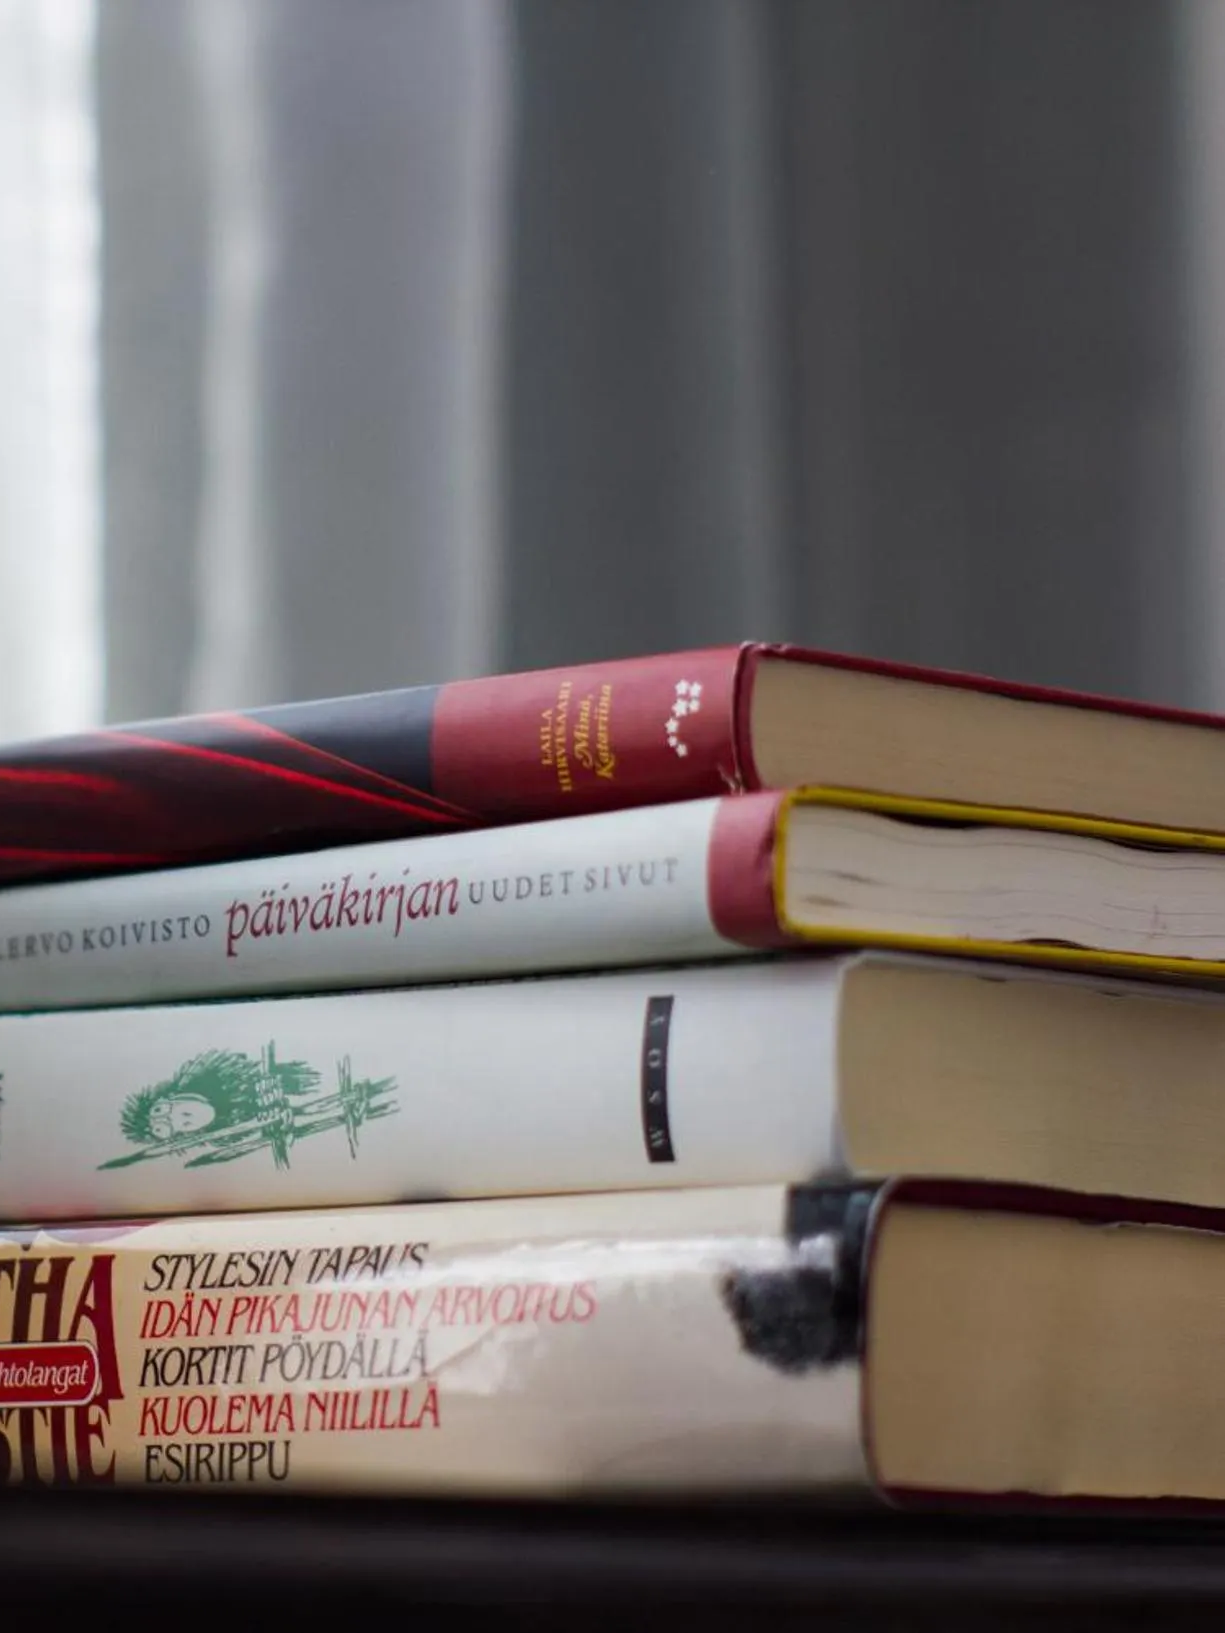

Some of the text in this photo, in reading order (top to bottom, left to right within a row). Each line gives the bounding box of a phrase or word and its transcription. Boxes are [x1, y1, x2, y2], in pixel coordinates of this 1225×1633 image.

[539, 709, 553, 765] LAILA
[593, 684, 616, 779] Katariina
[82, 914, 211, 952] KOIVISTO
[224, 867, 460, 957] päiväkirjan
[468, 868, 575, 905] UUDET
[584, 857, 679, 893] SIVUT
[144, 1249, 296, 1291] STYLESIN
[140, 1281, 599, 1340] IDÄN PIKAJUNAN ARVOITUS
[138, 1328, 432, 1388] KORTIT PÖYDÄLLÄ
[138, 1381, 442, 1437] KUOLEMA NIILILLÄ
[144, 1440, 291, 1484] ESIRIPPU
